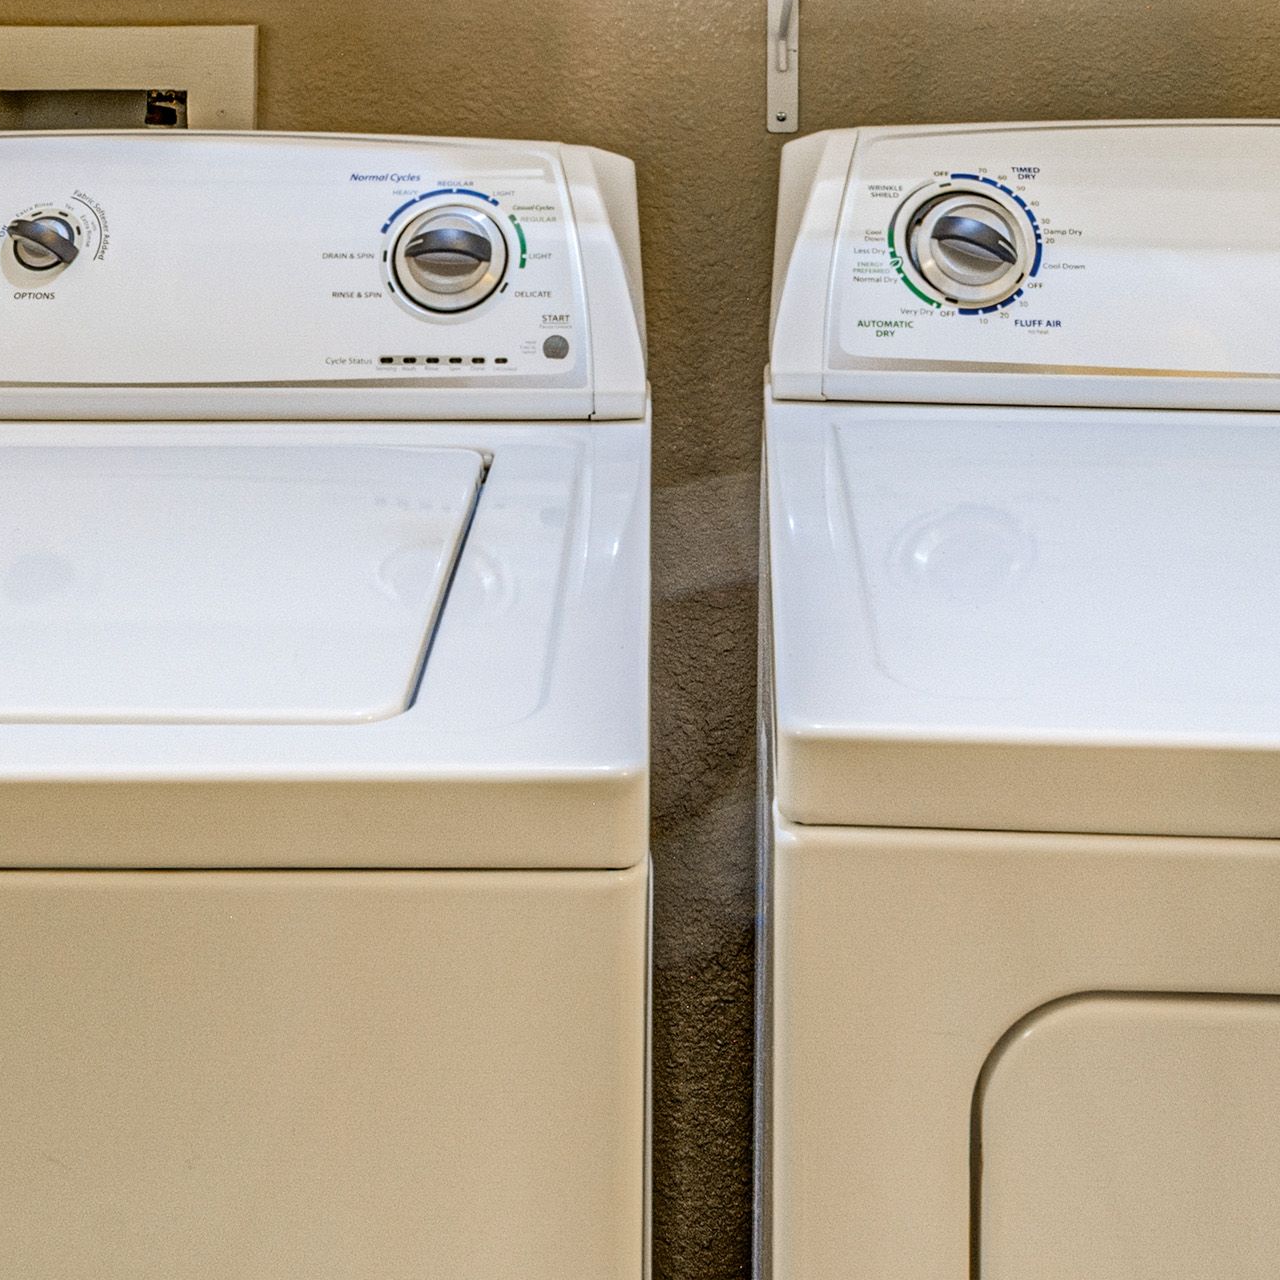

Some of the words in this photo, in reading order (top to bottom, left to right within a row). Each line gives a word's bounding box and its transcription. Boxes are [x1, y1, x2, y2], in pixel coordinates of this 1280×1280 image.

[350, 173, 387, 182] Normal
[390, 173, 421, 183] Cycles
[1043, 228, 1067, 236] Damp
[322, 252, 346, 260] DRAIN
[357, 252, 375, 260] SPIN
[13, 291, 56, 300] OPTIONS
[542, 314, 570, 322] START
[857, 320, 914, 328] AUTOMATIC
[1014, 319, 1043, 327] FLUFF
[325, 357, 347, 366] Cycle
[348, 357, 373, 365] Status
